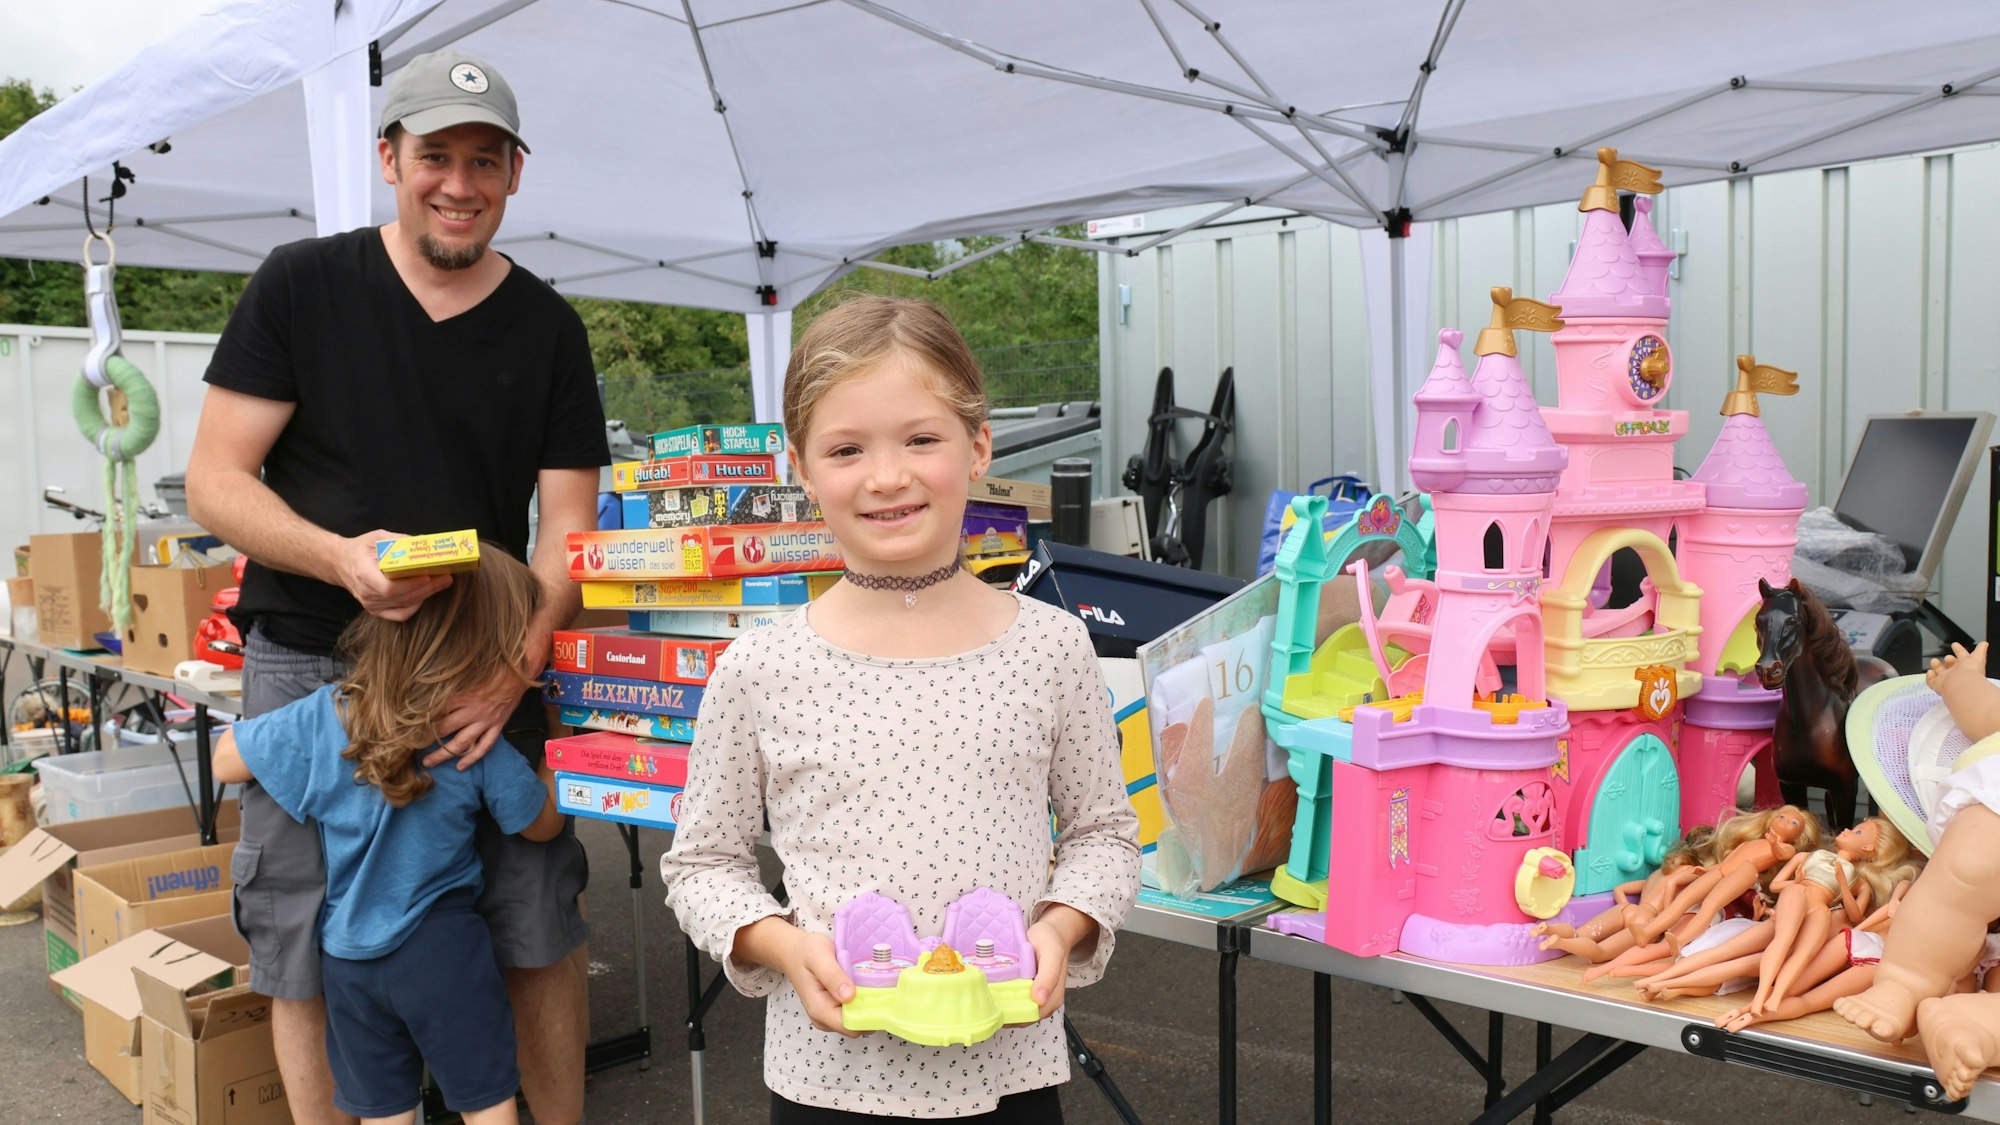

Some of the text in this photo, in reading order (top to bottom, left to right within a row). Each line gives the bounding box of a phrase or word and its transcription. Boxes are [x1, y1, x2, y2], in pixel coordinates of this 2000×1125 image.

[723, 427, 748, 438] HOCH-
[724, 438, 760, 449] STAPELN
[634, 464, 671, 482] Hut ab!
[715, 463, 766, 476] Hut ab!
[655, 511, 690, 523] memory
[607, 538, 675, 554] wunderwelt
[770, 531, 835, 547] wunderw
[608, 556, 676, 571] wissen das spiel
[771, 548, 819, 563] wissen
[1077, 604, 1125, 626] FILA
[555, 641, 576, 661] 500
[606, 651, 646, 665] Castorland
[1216, 648, 1254, 700] 16
[581, 677, 684, 710] HEXENTANZ
[148, 865, 221, 899] öffnen!
